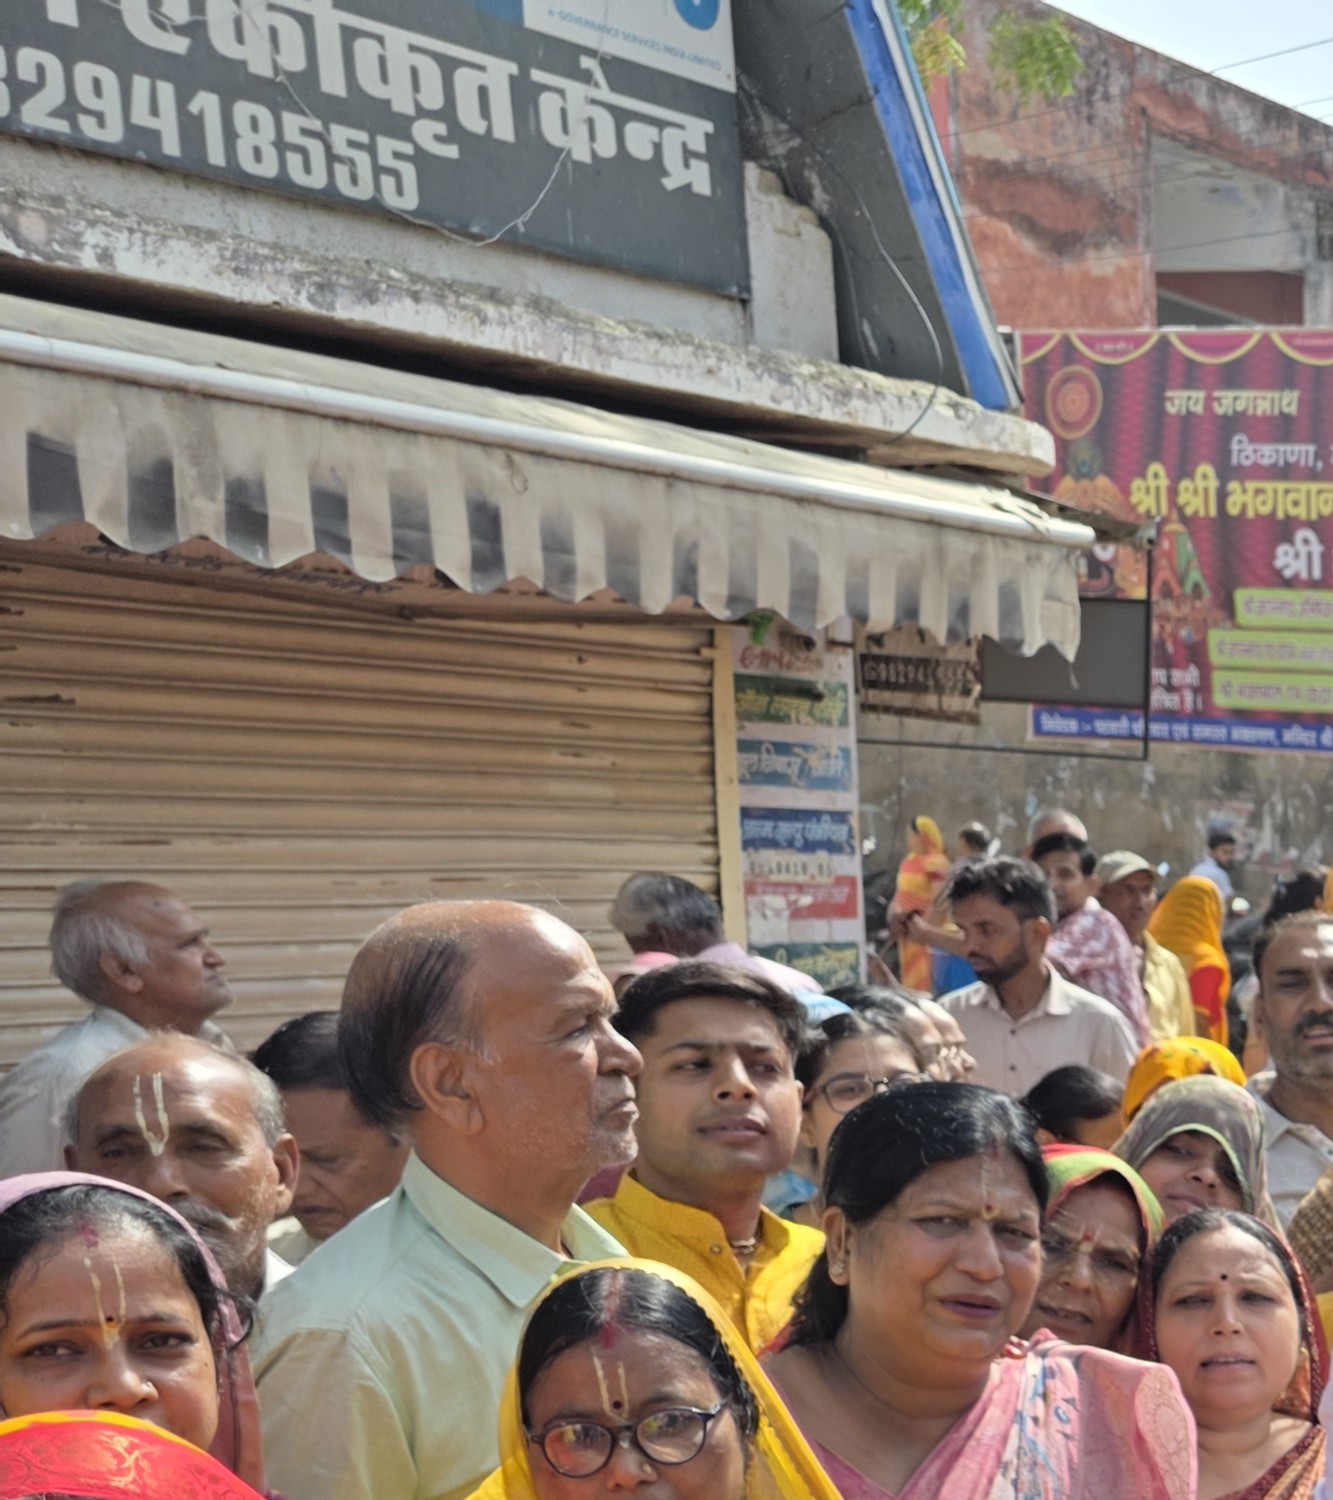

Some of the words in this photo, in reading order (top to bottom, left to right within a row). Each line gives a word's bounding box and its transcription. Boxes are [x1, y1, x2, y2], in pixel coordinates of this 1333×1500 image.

[0, 45, 420, 212] 29418555
[529, 54, 715, 197] केन्द्र
[1164, 388, 1206, 417] जय
[1212, 388, 1301, 417] जगन्नाथ
[1130, 462, 1170, 518] श्री
[1176, 463, 1220, 518] श्री
[1273, 528, 1323, 582] श्री
